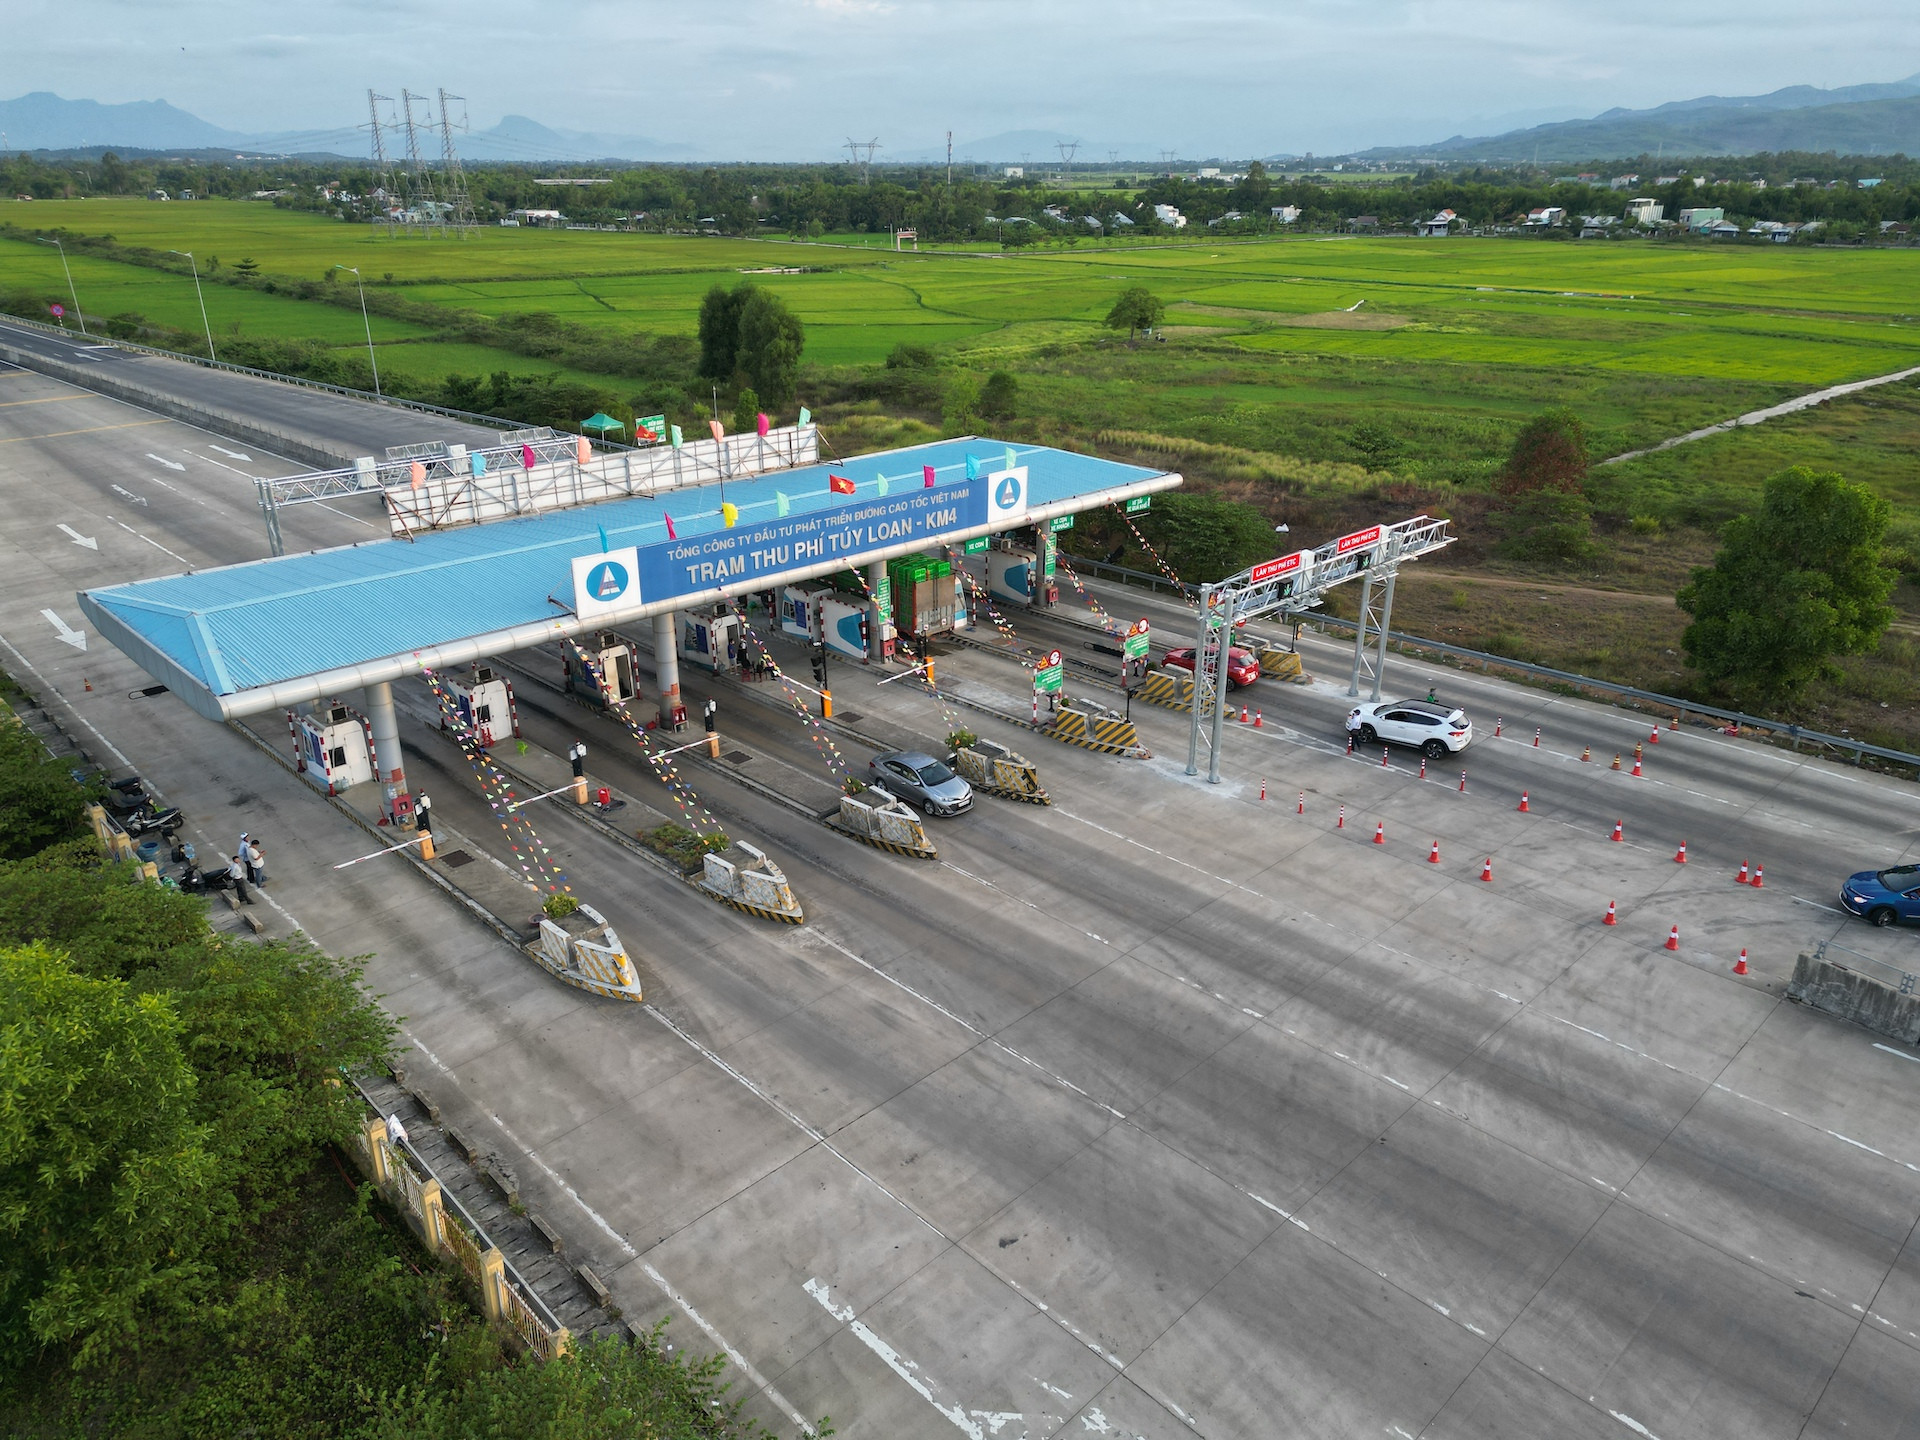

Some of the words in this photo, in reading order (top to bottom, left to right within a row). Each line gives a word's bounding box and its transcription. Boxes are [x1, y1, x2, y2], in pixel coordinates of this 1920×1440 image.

[667, 543, 700, 561] TỔNG
[703, 539, 735, 553] CÔNG
[737, 534, 752, 546] TY
[754, 527, 777, 543] ĐẦU
[778, 524, 793, 538] TƯ
[795, 518, 821, 534] PHÁT
[824, 509, 853, 527] TRIỂN
[854, 505, 887, 521] ĐƯỜNG
[888, 501, 908, 514] CAO
[911, 495, 928, 509] TỐC
[930, 491, 949, 505] VIỆT
[951, 488, 970, 501] NAM
[686, 554, 745, 584] TRẠM
[750, 545, 790, 570] THU
[794, 533, 825, 560] PHÍ
[828, 526, 864, 552] TÚY
[868, 518, 913, 544] LOAN
[926, 507, 957, 530] KM4
